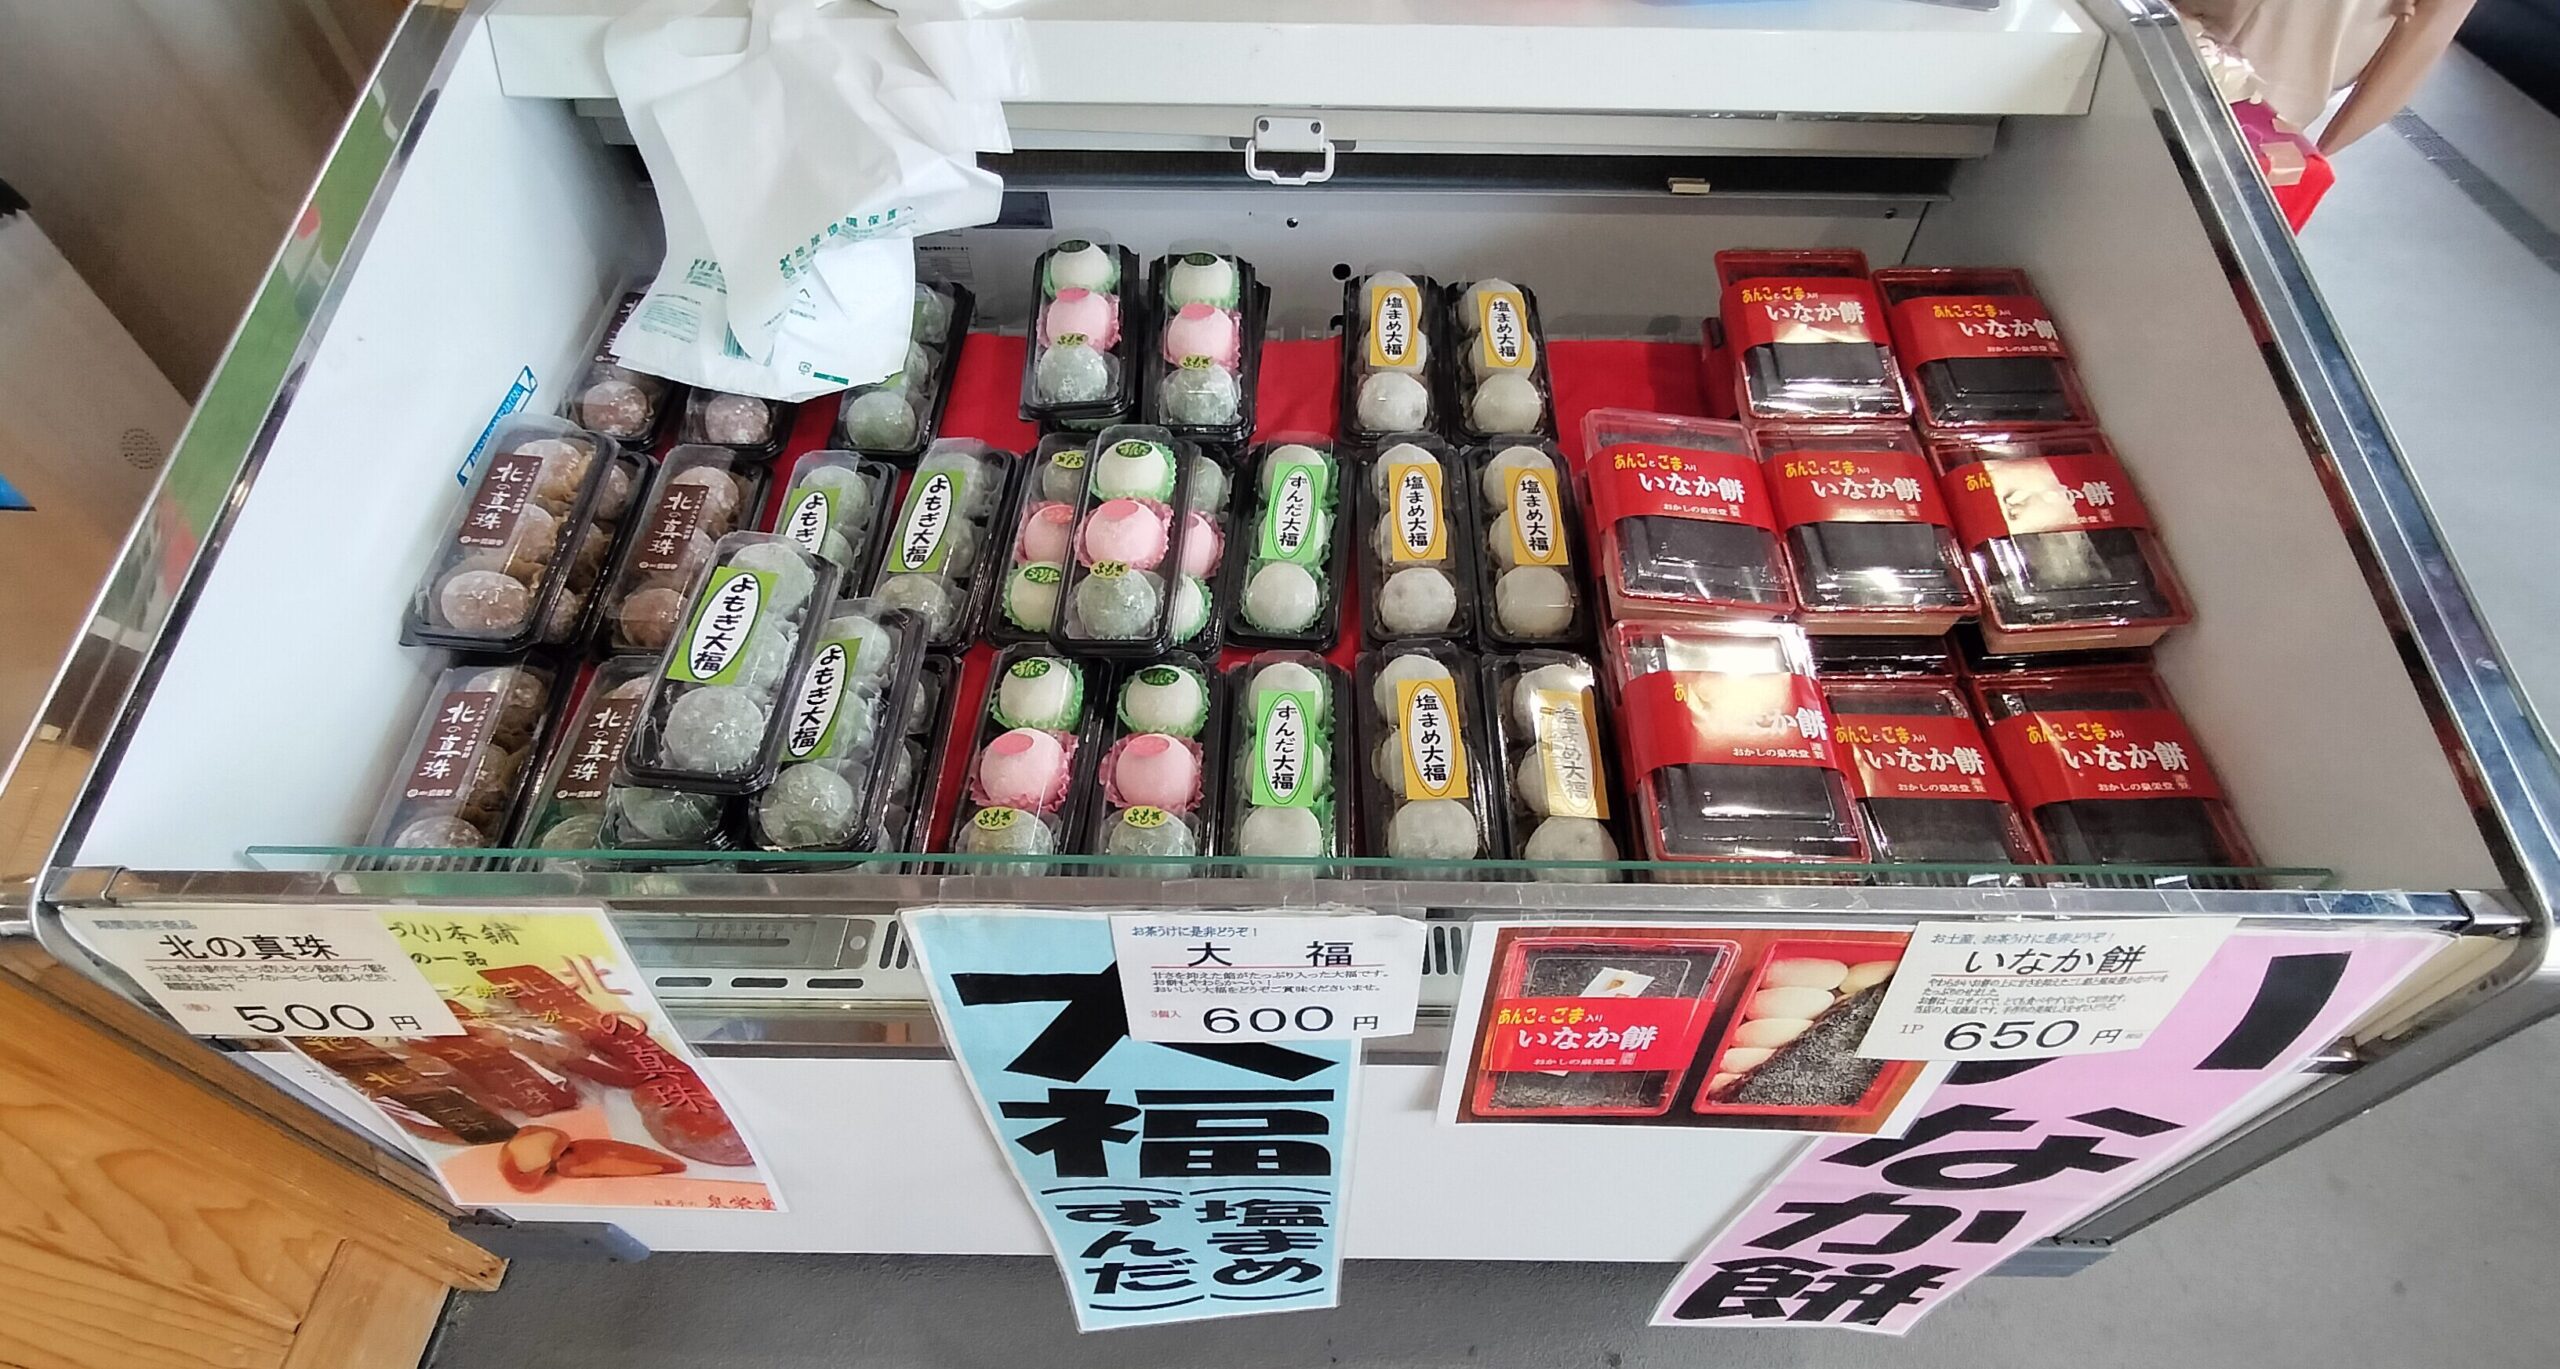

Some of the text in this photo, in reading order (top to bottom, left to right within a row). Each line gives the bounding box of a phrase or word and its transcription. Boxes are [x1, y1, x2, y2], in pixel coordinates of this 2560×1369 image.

[1385, 296, 1403, 356] 塩まめ大福
[1492, 300, 1517, 358] 塩まめ大福
[1766, 301, 1865, 325] いなか餅
[1958, 319, 2060, 342] いなか餅
[470, 461, 524, 530] 北の真珠
[1638, 472, 1745, 504] いなか餅
[1810, 476, 1923, 503] いなか餅
[647, 491, 693, 556] 北の真珠
[905, 477, 948, 563] よもぎ大福
[1279, 475, 1308, 548] ずんだ大福
[1404, 475, 1429, 548] 塩まめ大福
[1521, 478, 1550, 552] 塩まめ大福
[693, 577, 756, 672] よもぎ大福
[791, 647, 842, 749] よもぎ大福
[418, 700, 476, 779] 北の真珠
[567, 706, 622, 781] 北の真珠
[1271, 704, 1298, 792] ずんだ大福
[1415, 693, 1447, 782] 塩まめ大福
[2059, 741, 2191, 772] いなか餅
[1868, 746, 1986, 777] いなか餅
[157, 933, 341, 960] 北の真珠
[1131, 925, 1259, 938] お茶うけに是非どうぞ！
[410, 950, 489, 967] の一品
[1964, 945, 2148, 976] いなか餅
[233, 1004, 422, 1034] 500 円
[561, 953, 719, 1113] 北の真珠
[1203, 1006, 1379, 1034] 600 円
[1517, 1025, 1660, 1051] いなか餅
[1900, 1023, 1925, 1035] 1P
[1943, 1019, 2081, 1052] 650
[2089, 1028, 2124, 1046] 円
